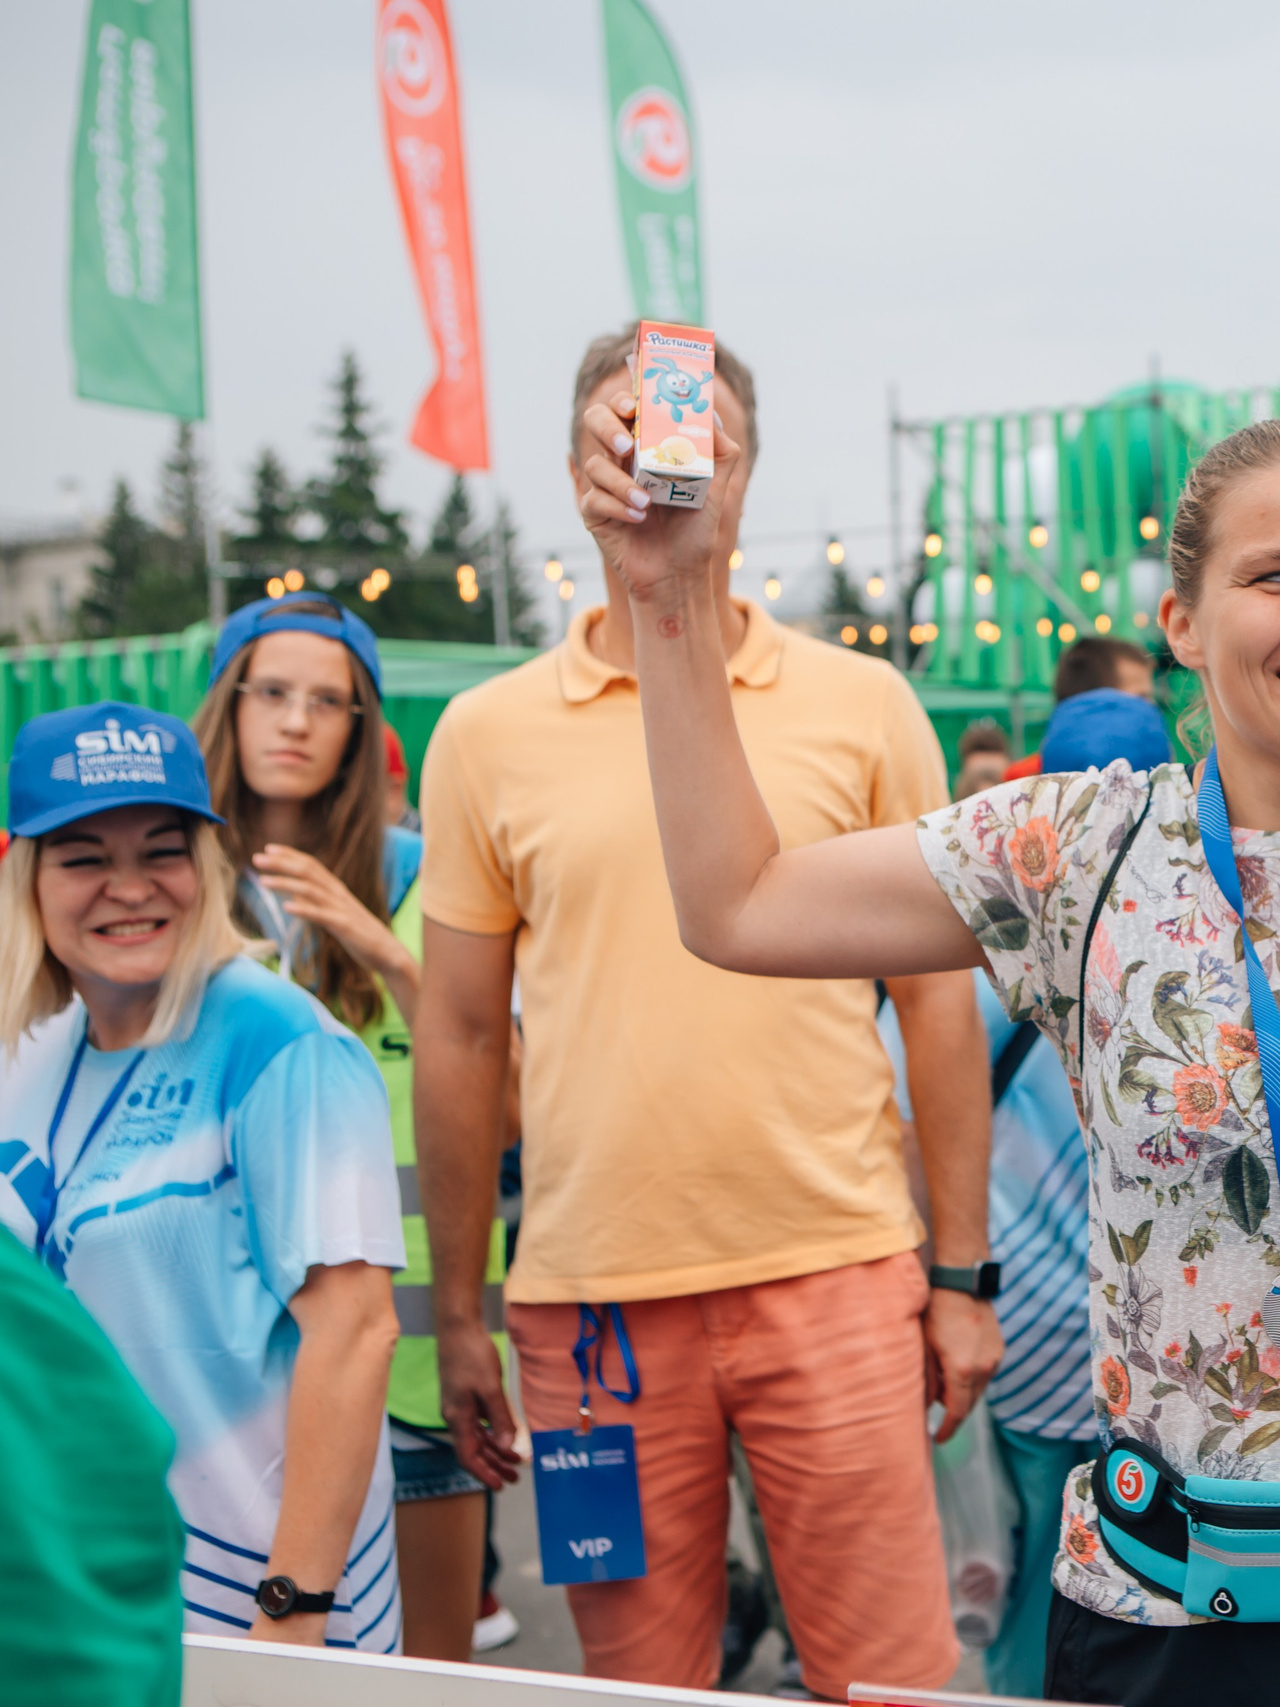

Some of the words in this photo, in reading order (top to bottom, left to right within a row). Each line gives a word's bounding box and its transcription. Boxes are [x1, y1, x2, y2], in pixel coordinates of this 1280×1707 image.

[648, 332, 708, 353] Растишка
[1119, 1459, 1141, 1498] 5
[567, 1536, 613, 1559] VIP
